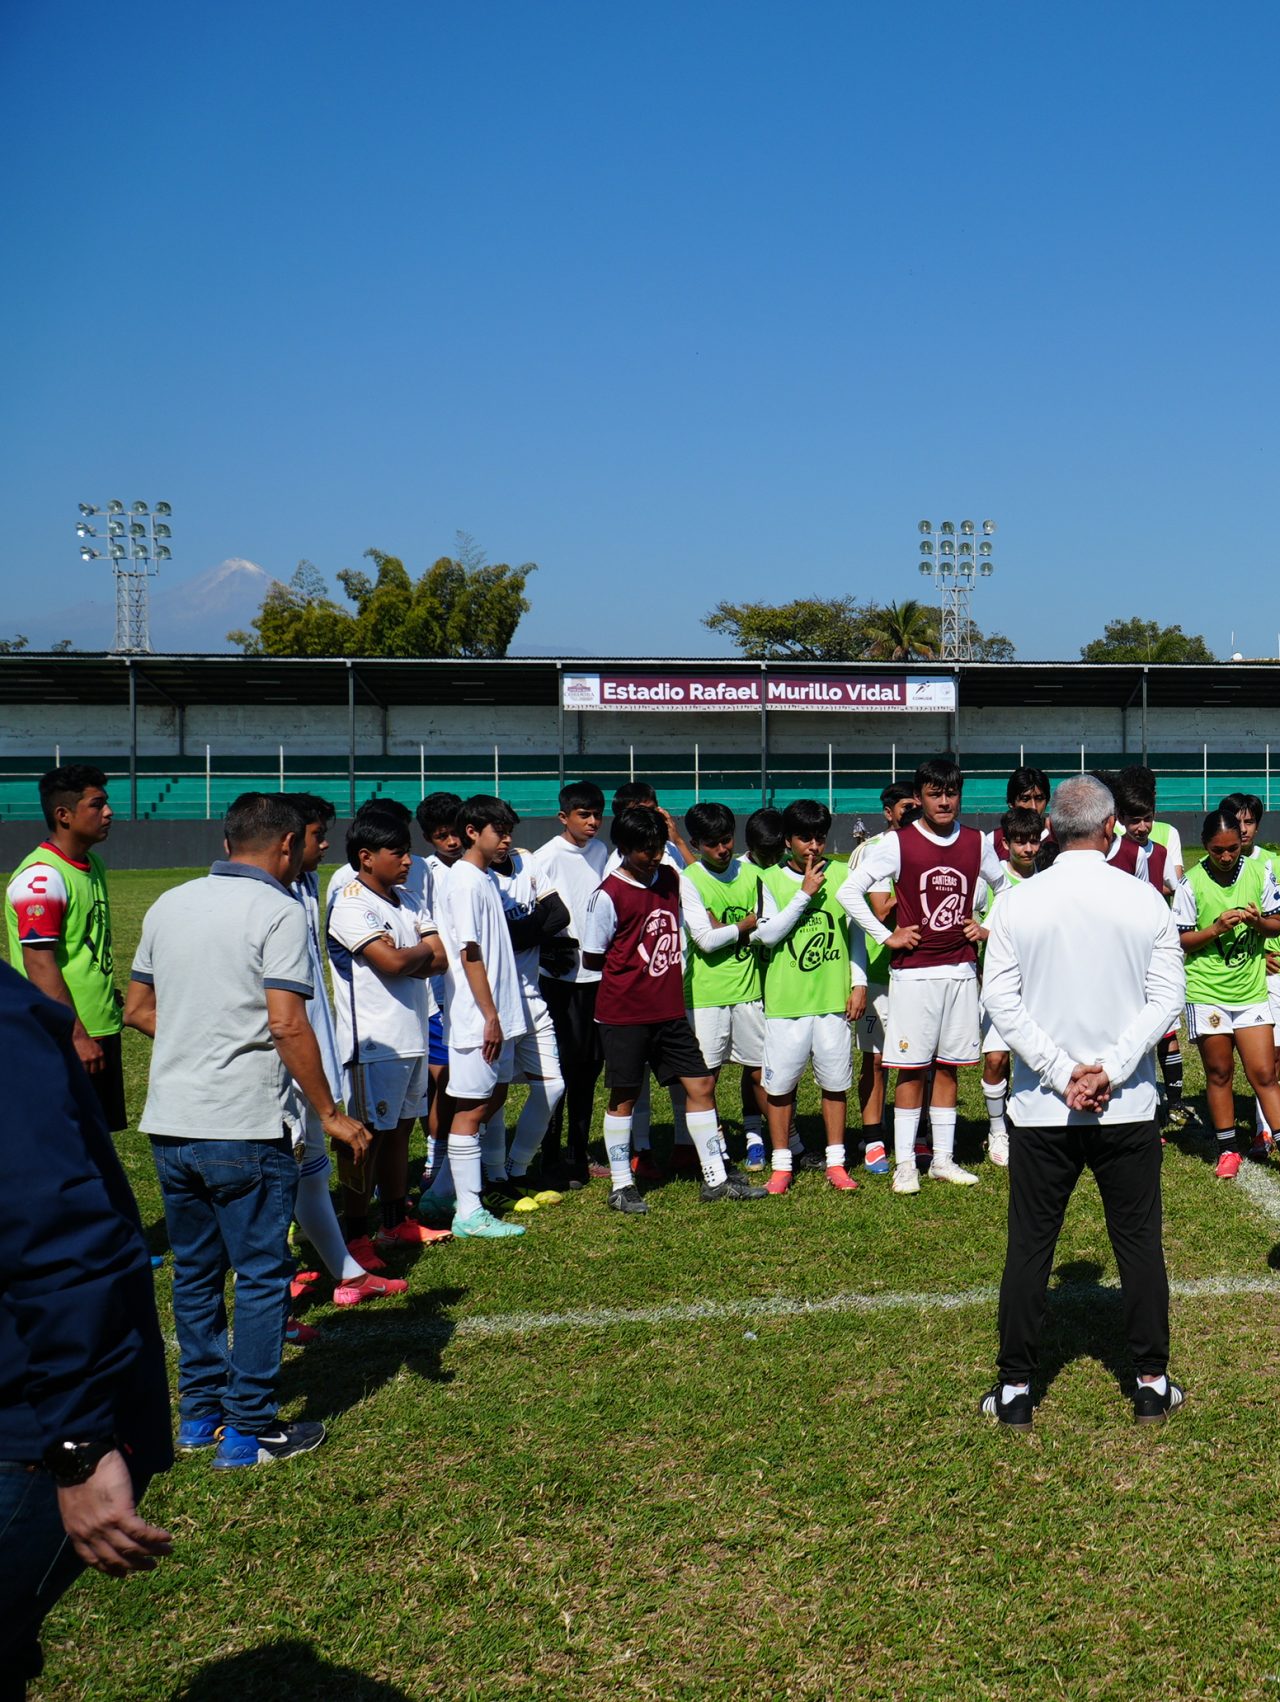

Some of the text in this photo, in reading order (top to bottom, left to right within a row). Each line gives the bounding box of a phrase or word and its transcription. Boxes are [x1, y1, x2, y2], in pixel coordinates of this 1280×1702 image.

[603, 682, 901, 701] Estadio Rafael Murillo Vidal
[932, 874, 958, 887] CANTERAS
[866, 1015, 877, 1034] 7
